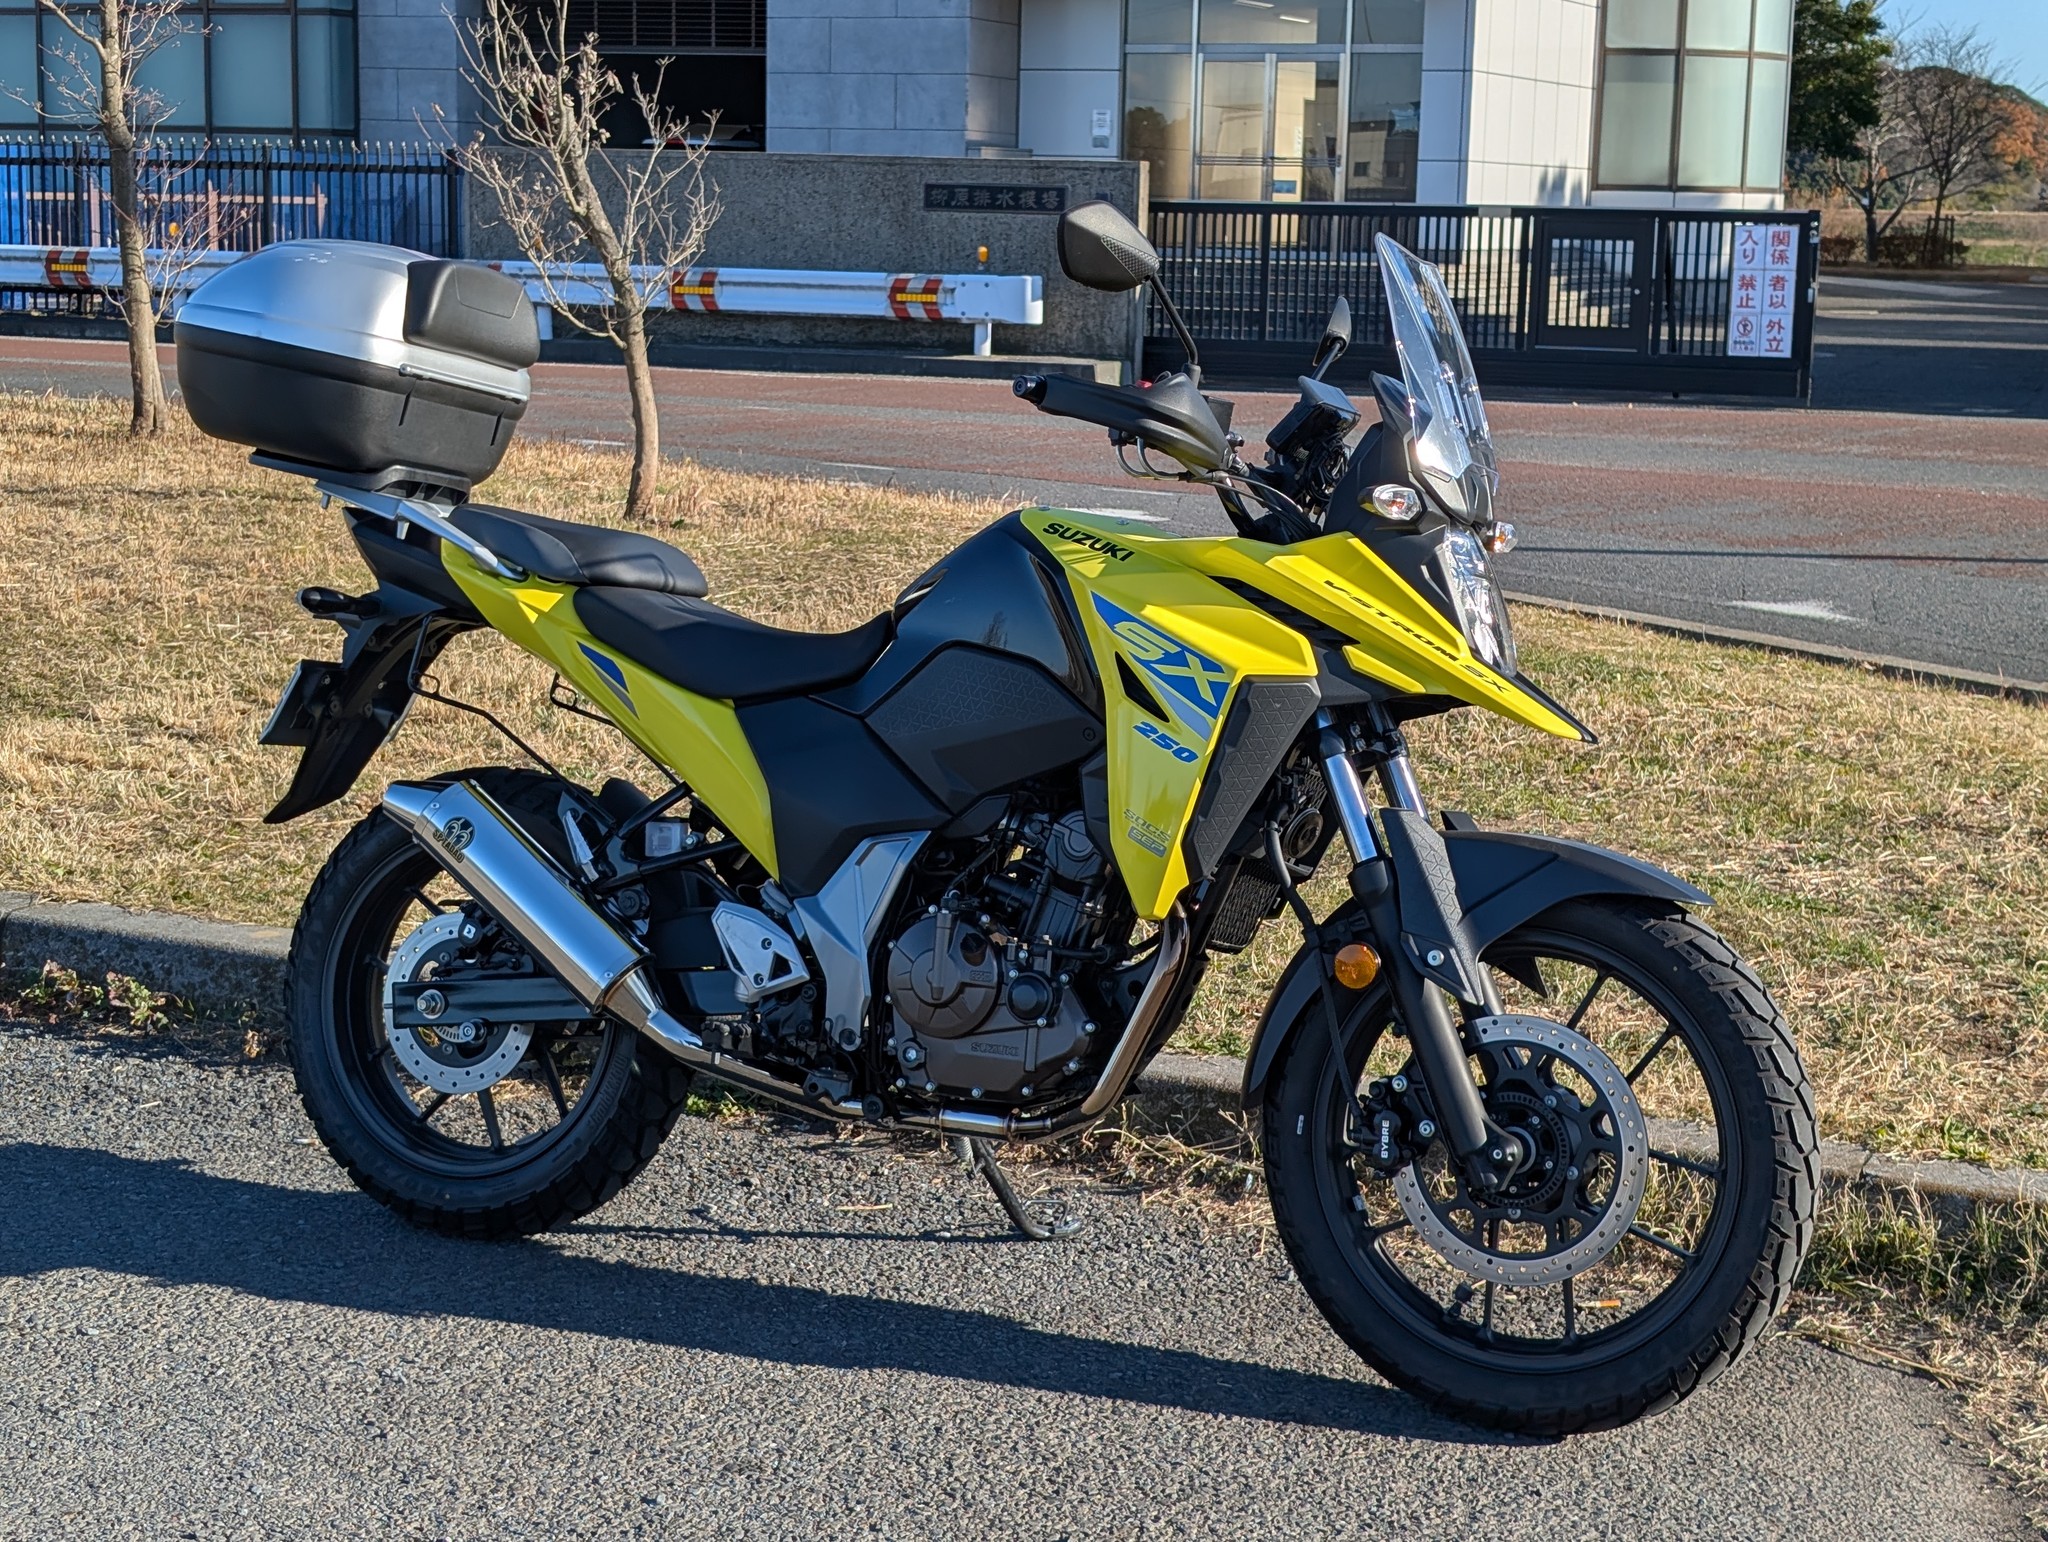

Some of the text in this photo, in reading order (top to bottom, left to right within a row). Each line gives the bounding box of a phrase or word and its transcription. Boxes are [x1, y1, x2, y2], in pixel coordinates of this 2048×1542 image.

[1736, 229, 1759, 309] 入り禁止
[1764, 230, 1791, 353] 関係者以外立
[1042, 522, 1135, 562] SUZUKI
[1323, 580, 1510, 693] V-STROM SX
[1113, 621, 1231, 707] SX
[1132, 720, 1200, 764] 250
[1123, 808, 1171, 841] SOCS
[1130, 828, 1165, 851] SEP
[970, 1041, 1020, 1057] SUZUKI
[1380, 1119, 1390, 1159] BYBRE
